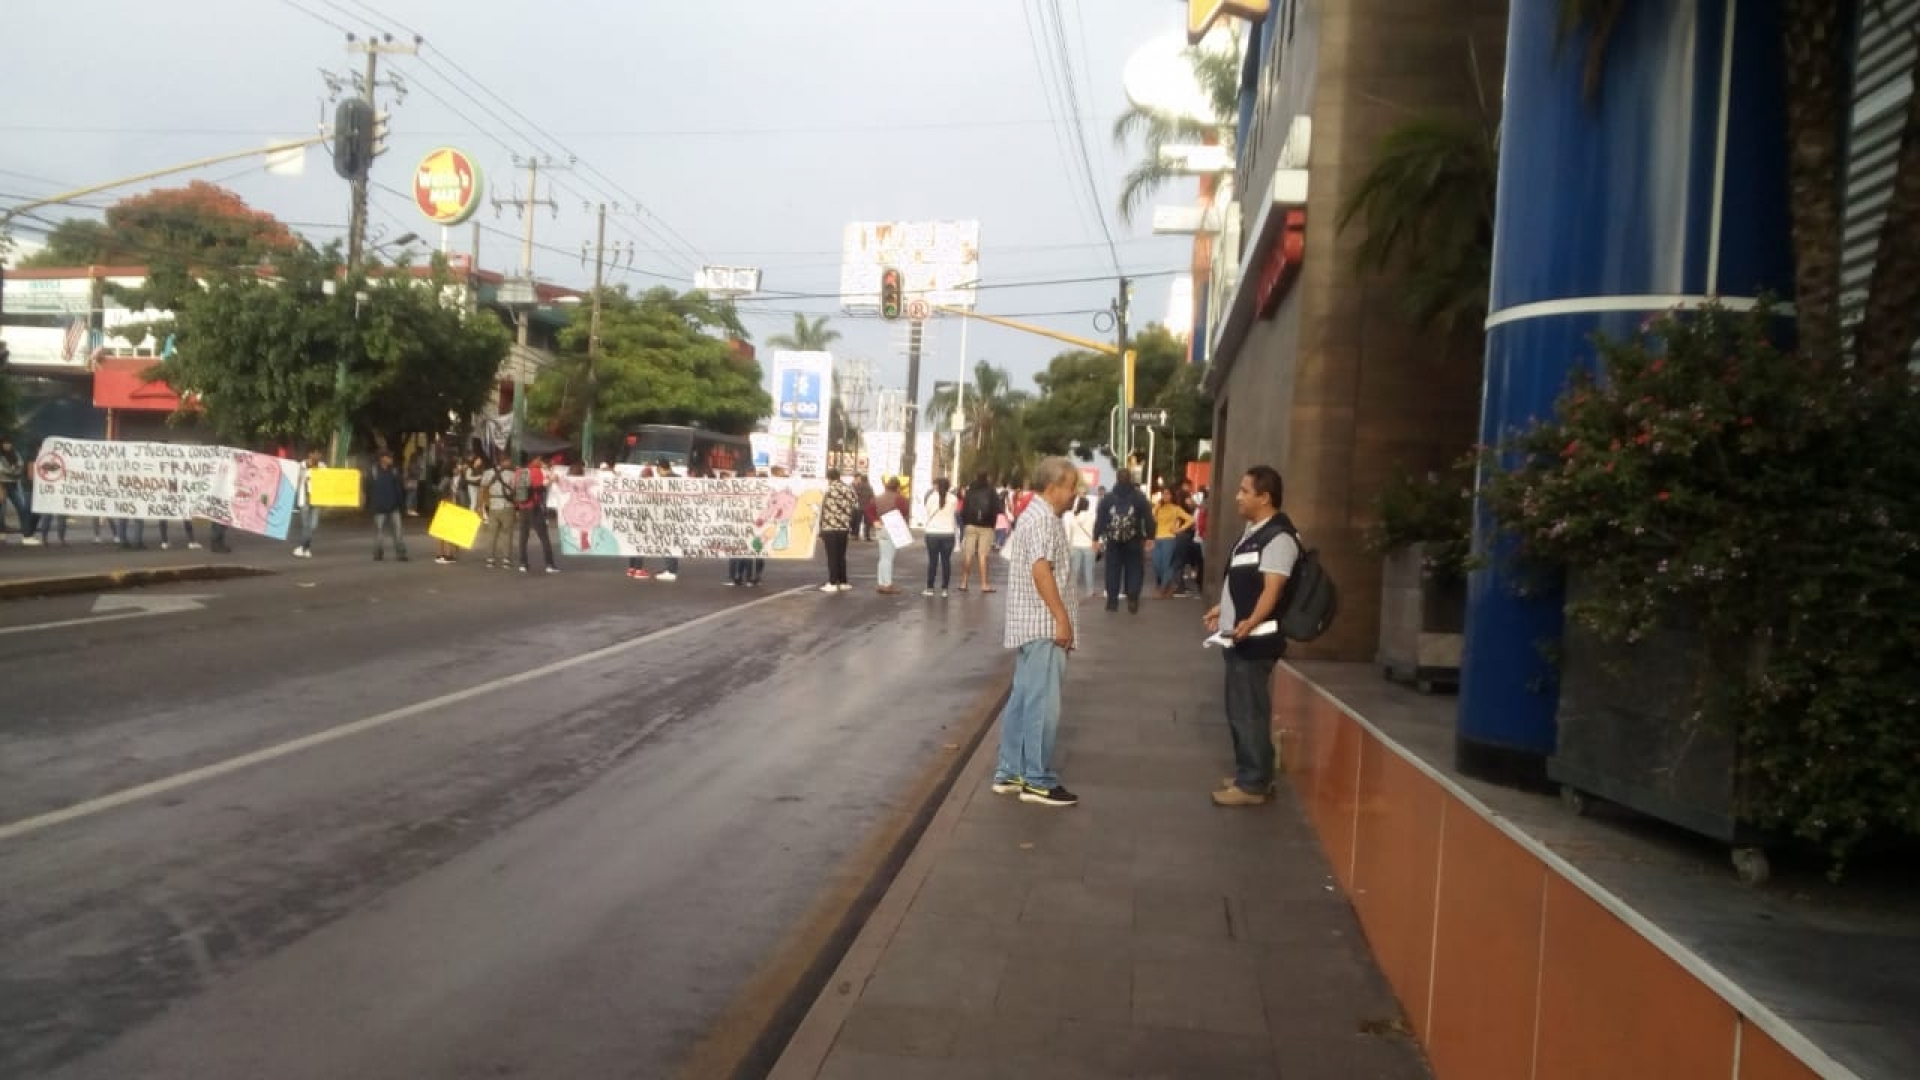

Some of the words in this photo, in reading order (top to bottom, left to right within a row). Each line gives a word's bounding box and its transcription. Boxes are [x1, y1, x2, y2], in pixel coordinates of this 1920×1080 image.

[53, 441, 126, 458] PROGRAMA
[66, 470, 110, 487] FAMILIA
[117, 475, 178, 493] RABADAN
[603, 479, 619, 491] SE
[621, 478, 663, 493] ROBAN
[669, 480, 729, 493] NUESTRAS
[731, 480, 768, 492] BECAS
[64, 497, 78, 511] DE
[84, 498, 107, 511] QUE
[114, 501, 137, 515] NOS
[749, 497, 764, 510] DE
[663, 507, 711, 522] ANDRES
[716, 508, 757, 523] MANUEL
[634, 522, 648, 535] NO
[627, 533, 639, 544] EL
